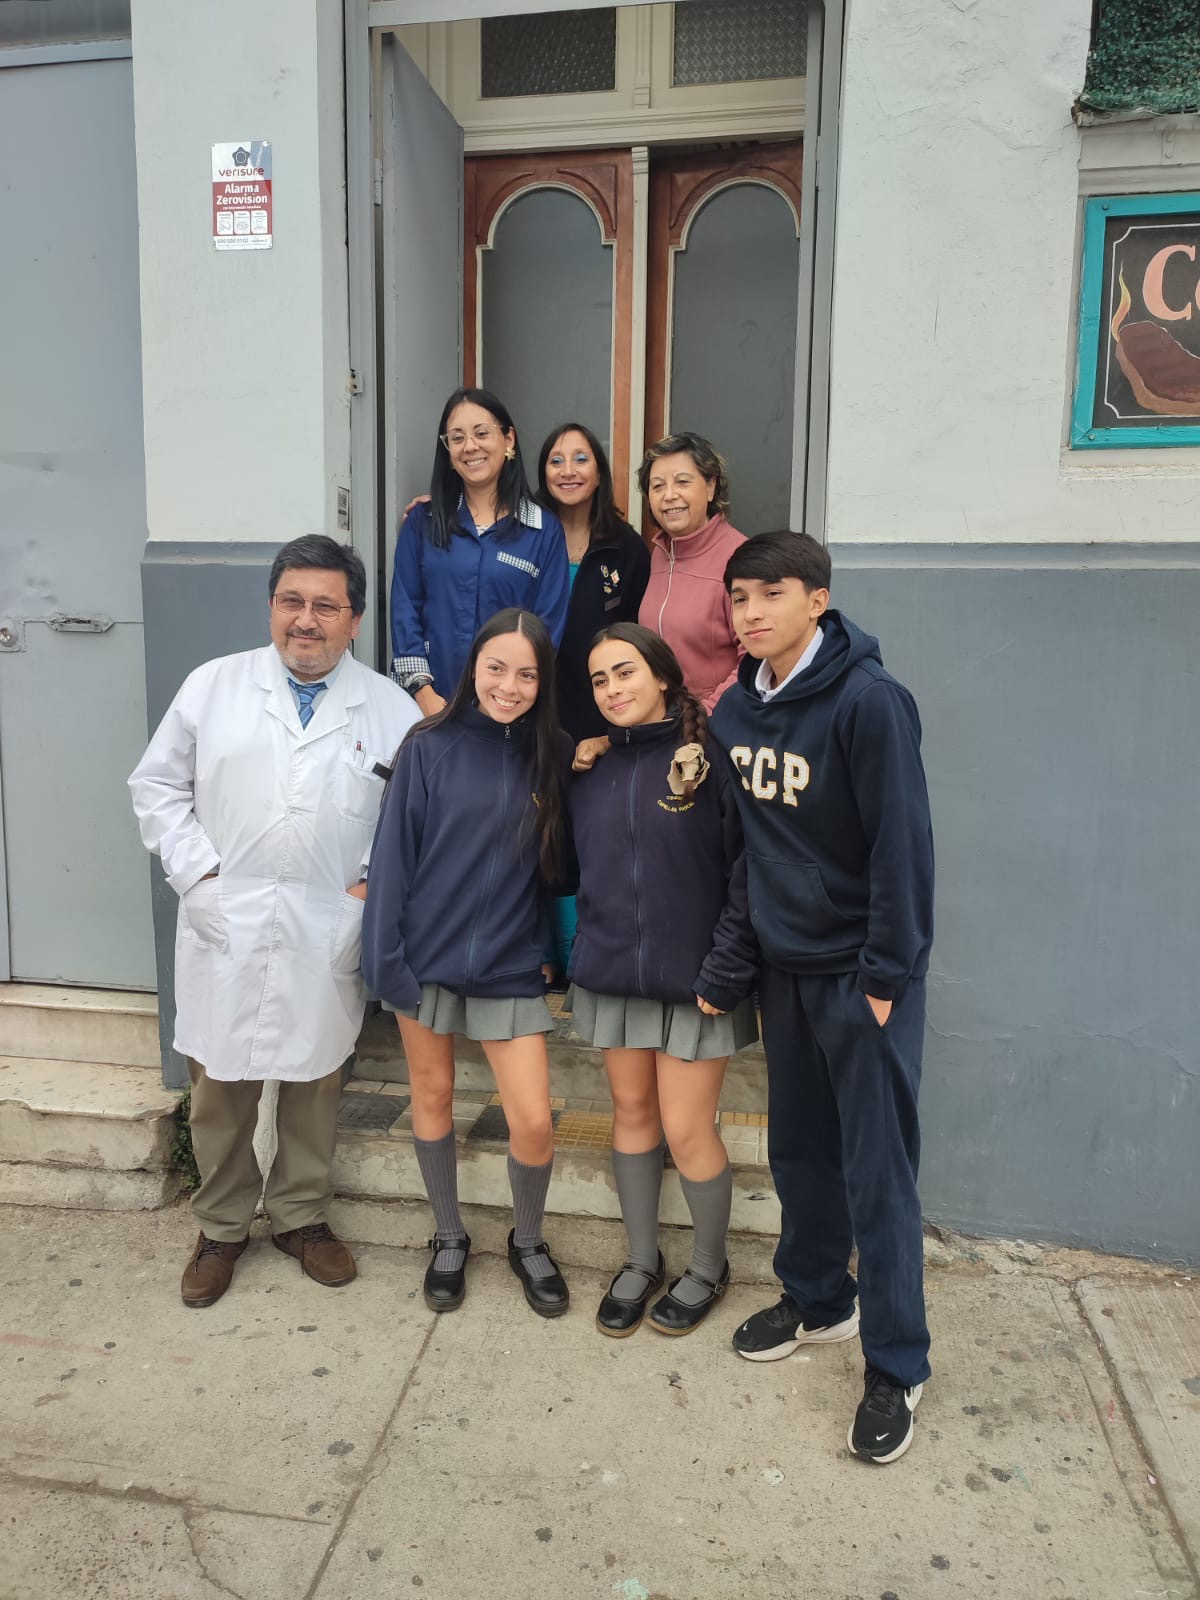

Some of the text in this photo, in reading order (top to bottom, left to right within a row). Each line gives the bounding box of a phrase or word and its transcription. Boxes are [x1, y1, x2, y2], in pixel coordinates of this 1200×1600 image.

[218, 167, 265, 177] verisure
[224, 183, 260, 194] Alarma
[216, 193, 268, 205] Zerovision
[1142, 244, 1200, 321] C
